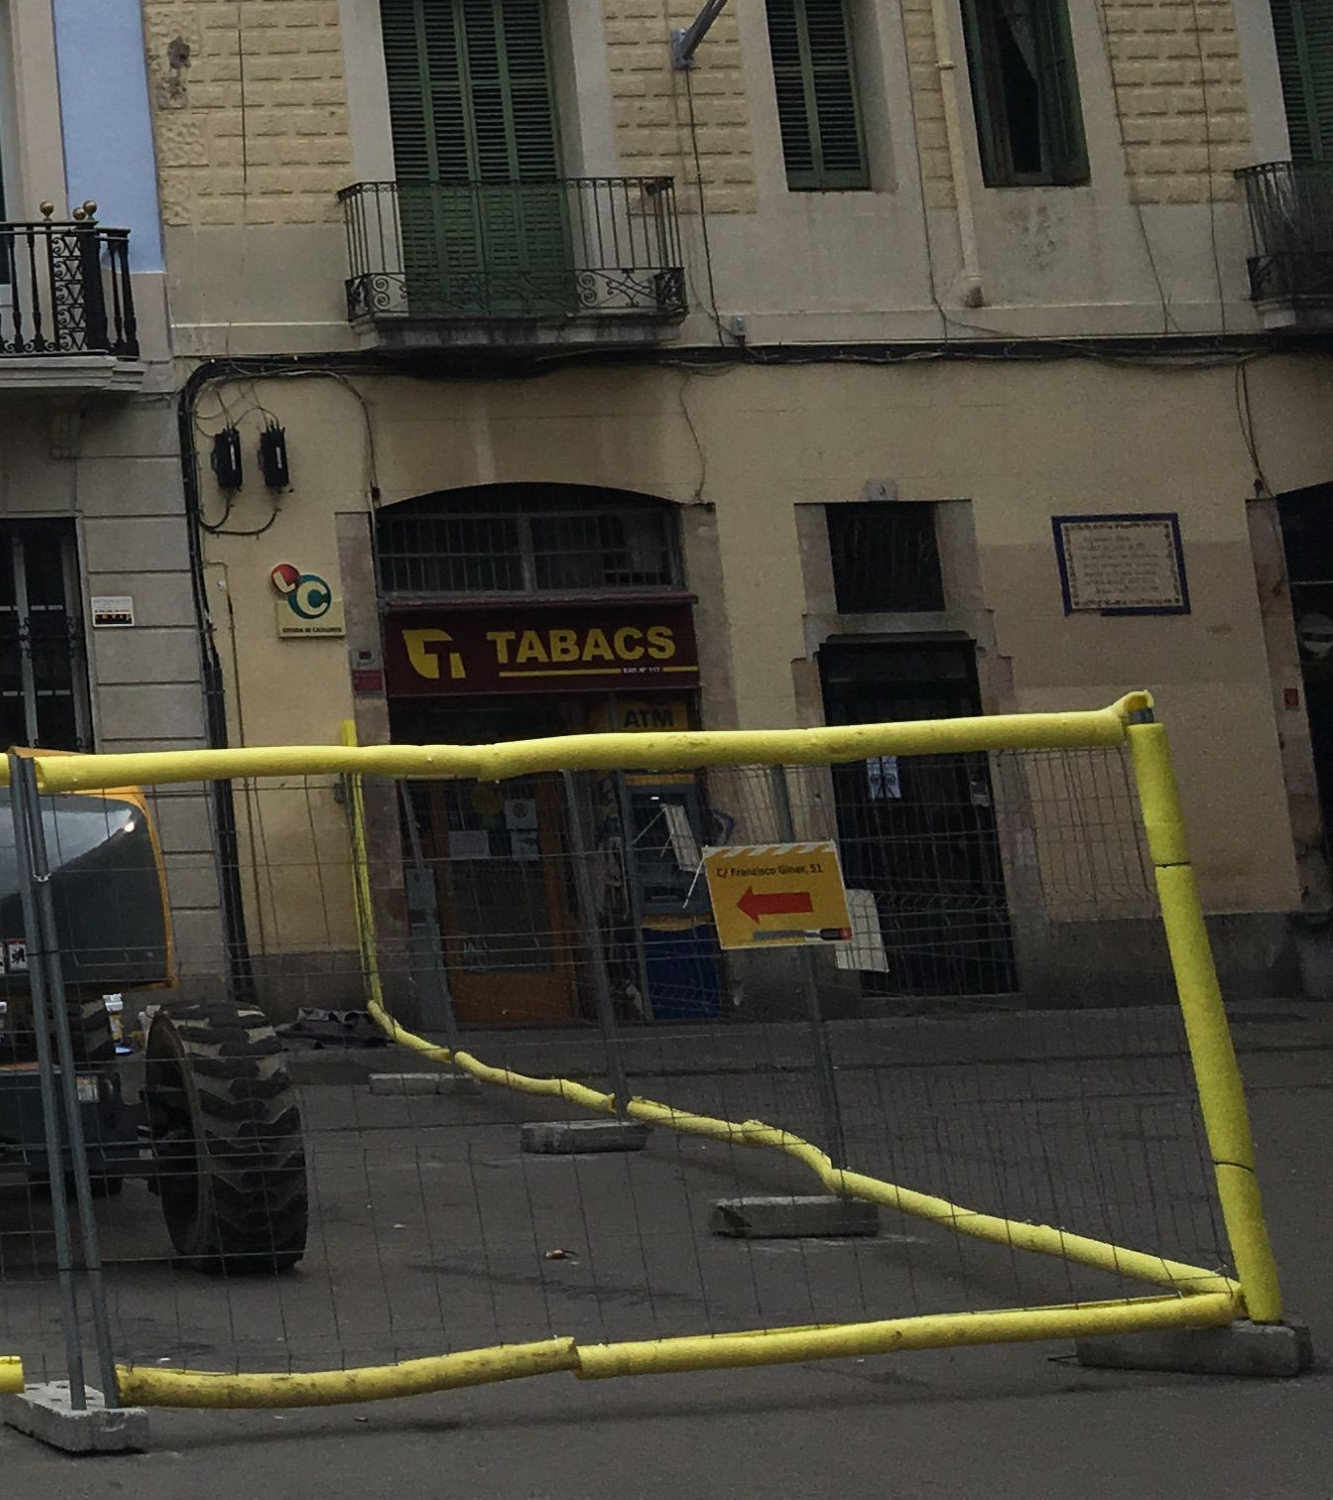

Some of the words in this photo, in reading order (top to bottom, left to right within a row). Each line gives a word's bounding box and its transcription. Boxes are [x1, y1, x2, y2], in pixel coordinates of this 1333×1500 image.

[486, 626, 676, 664] TABACS
[624, 709, 673, 729] ATM
[730, 866, 777, 877] Francisco
[810, 863, 823, 873] 51
